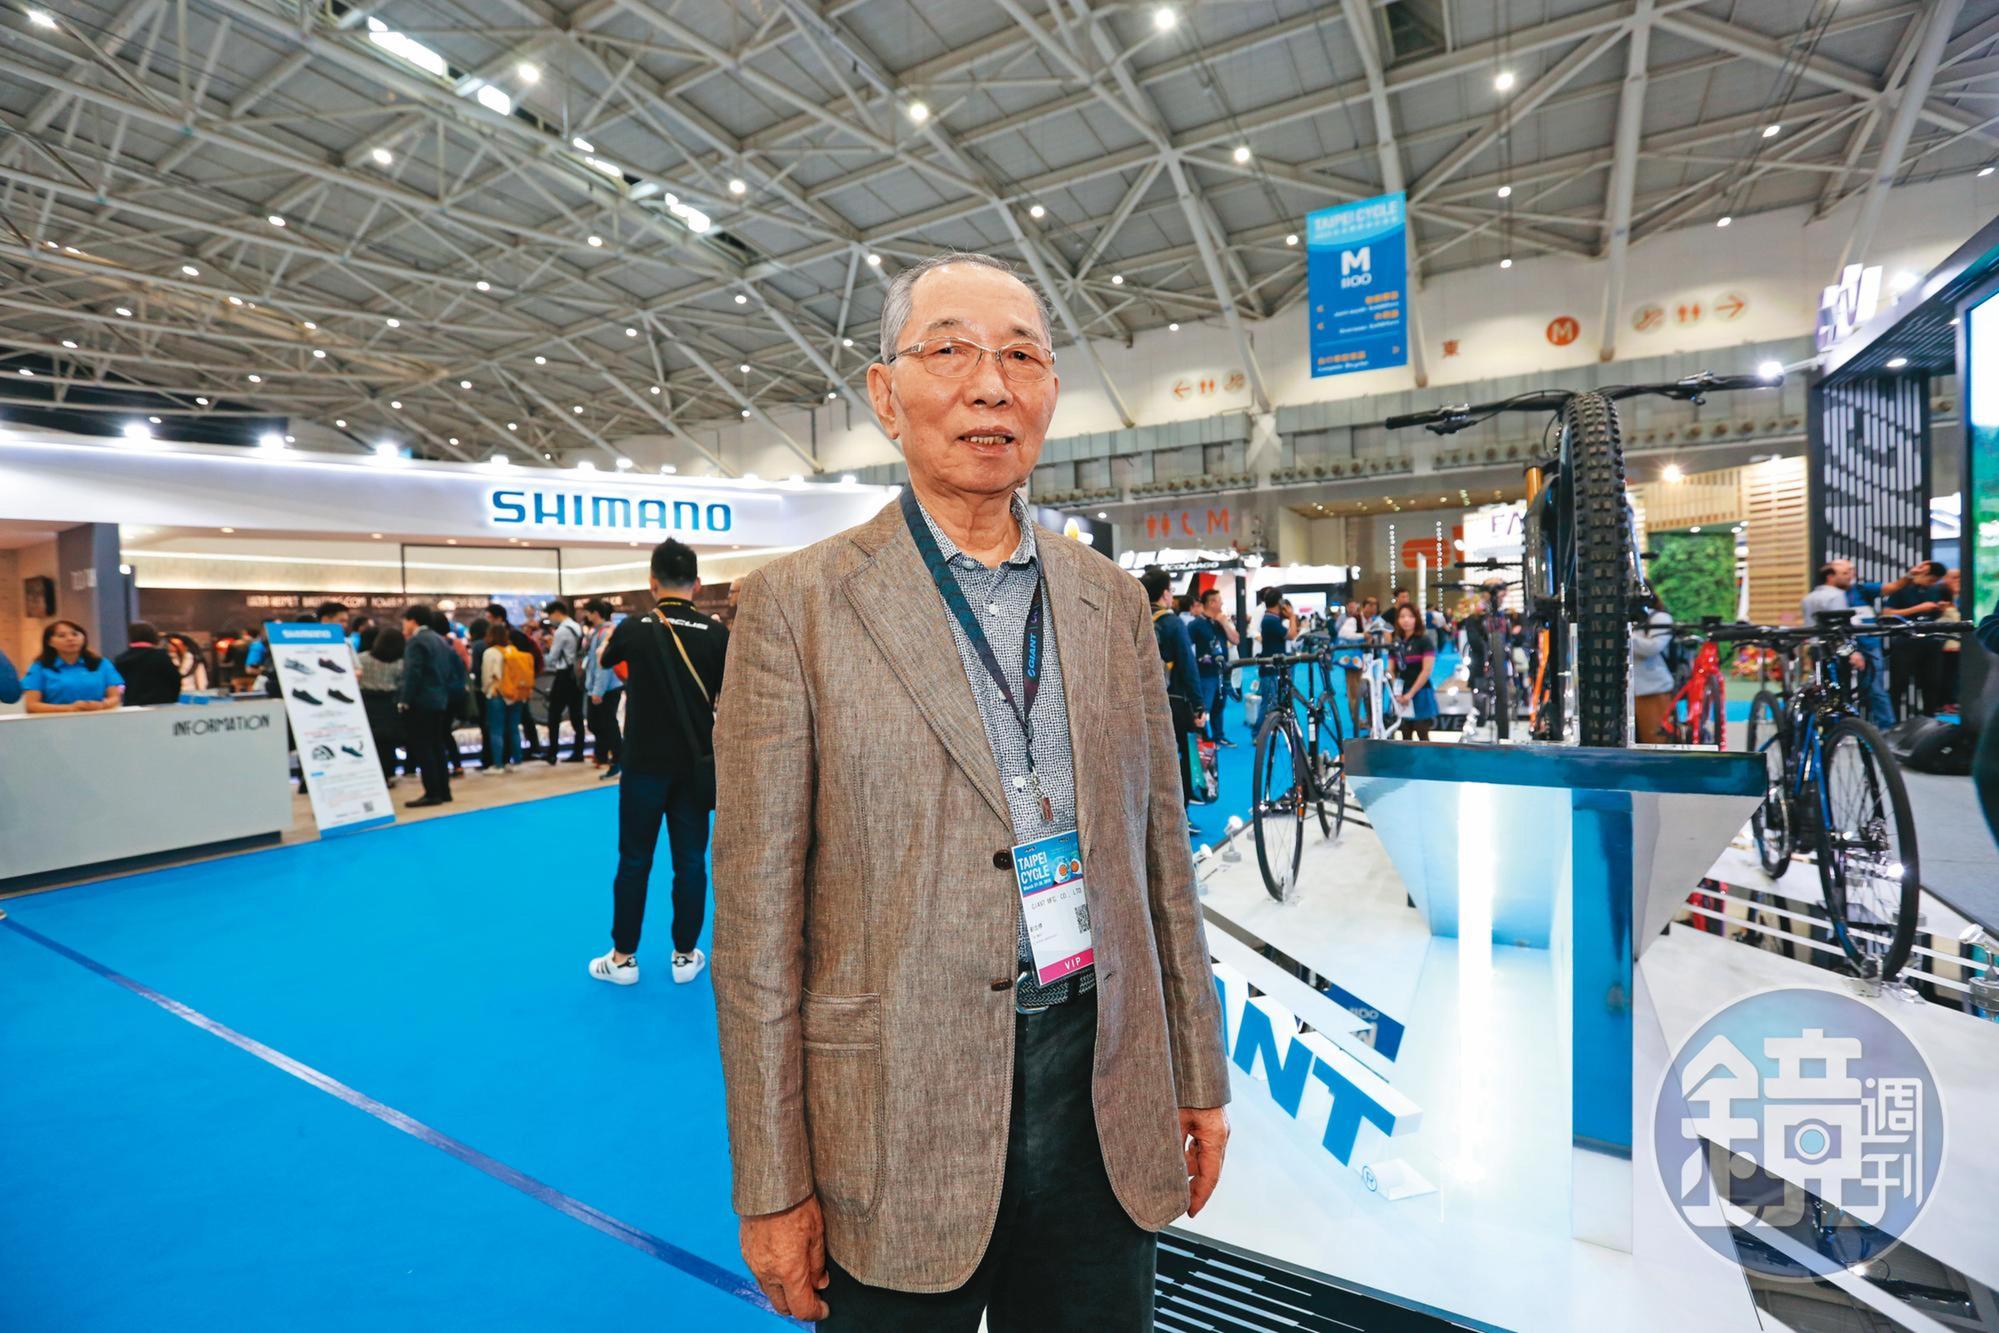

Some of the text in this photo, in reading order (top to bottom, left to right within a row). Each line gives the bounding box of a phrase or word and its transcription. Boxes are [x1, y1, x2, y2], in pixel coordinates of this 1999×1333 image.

[1341, 246, 1371, 276] M
[492, 490, 732, 532] SHIMANO
[1028, 632, 1038, 669] GIANT
[172, 714, 270, 736] INFORMATION
[1017, 851, 1048, 871] TAIPEI
[1020, 865, 1051, 885] CYCLE
[1064, 957, 1081, 970] VIP
